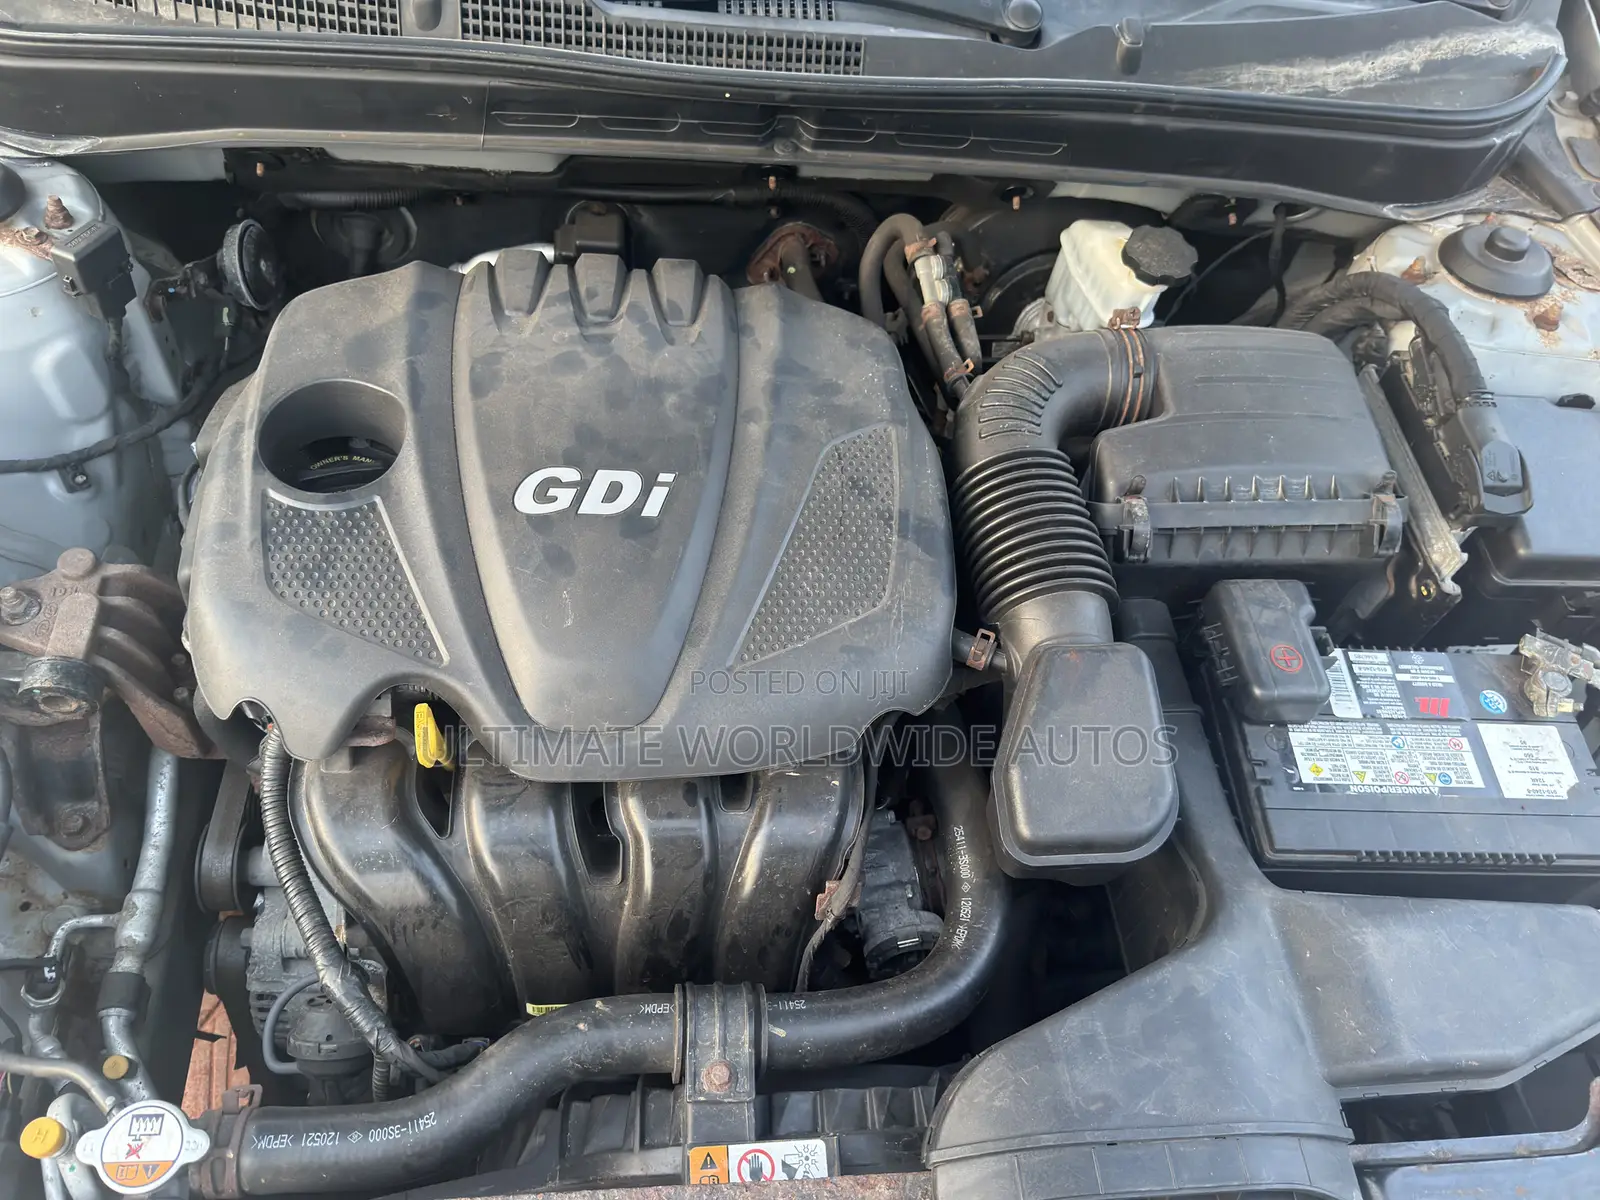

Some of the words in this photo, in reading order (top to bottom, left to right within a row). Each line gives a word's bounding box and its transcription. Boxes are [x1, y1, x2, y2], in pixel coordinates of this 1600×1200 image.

[310, 455, 349, 471] OWNER'S
[512, 466, 678, 518] GDi
[1349, 784, 1431, 795] DANGER/POISON
[952, 825, 971, 879] 25411-3S000
[368, 1111, 438, 1142] 25411-3S000
[301, 1131, 341, 1147] 120521
